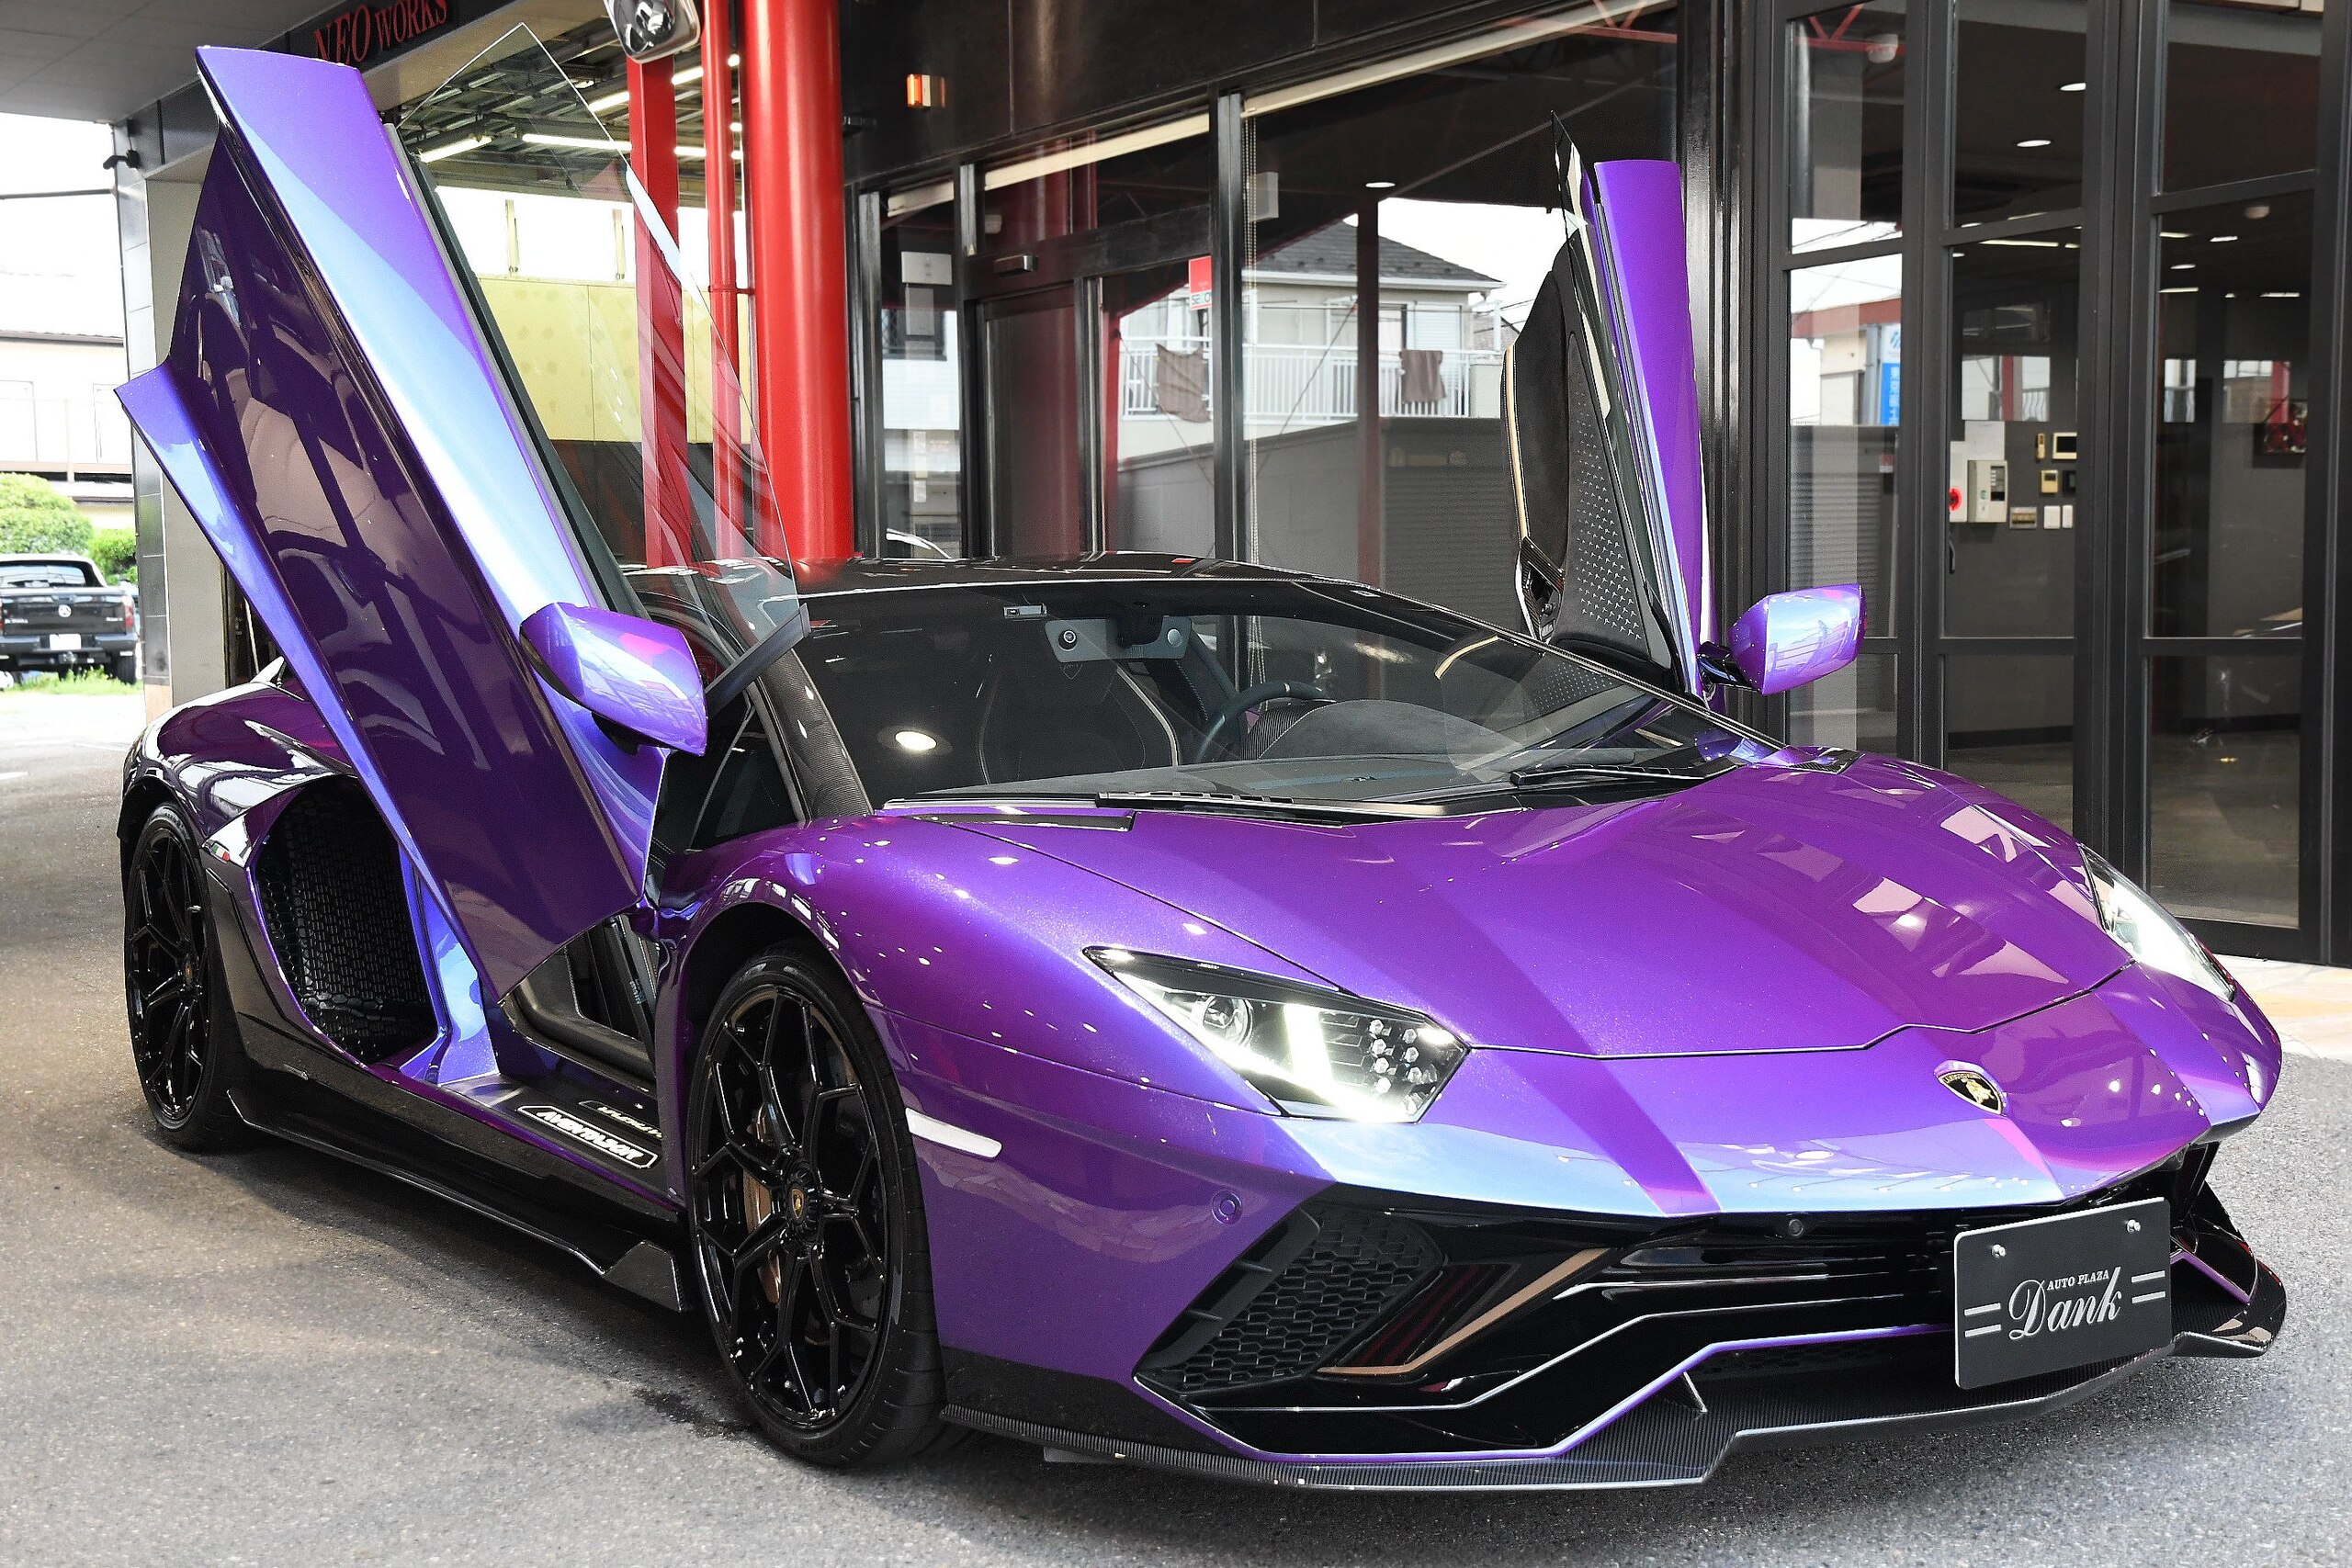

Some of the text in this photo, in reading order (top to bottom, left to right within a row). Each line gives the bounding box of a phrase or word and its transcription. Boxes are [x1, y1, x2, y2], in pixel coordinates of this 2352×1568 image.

[313, 0, 447, 65] NEO WORKS
[2008, 1267, 2122, 1340] Dank
[2047, 1269, 2109, 1291] AUTO PLAZA
